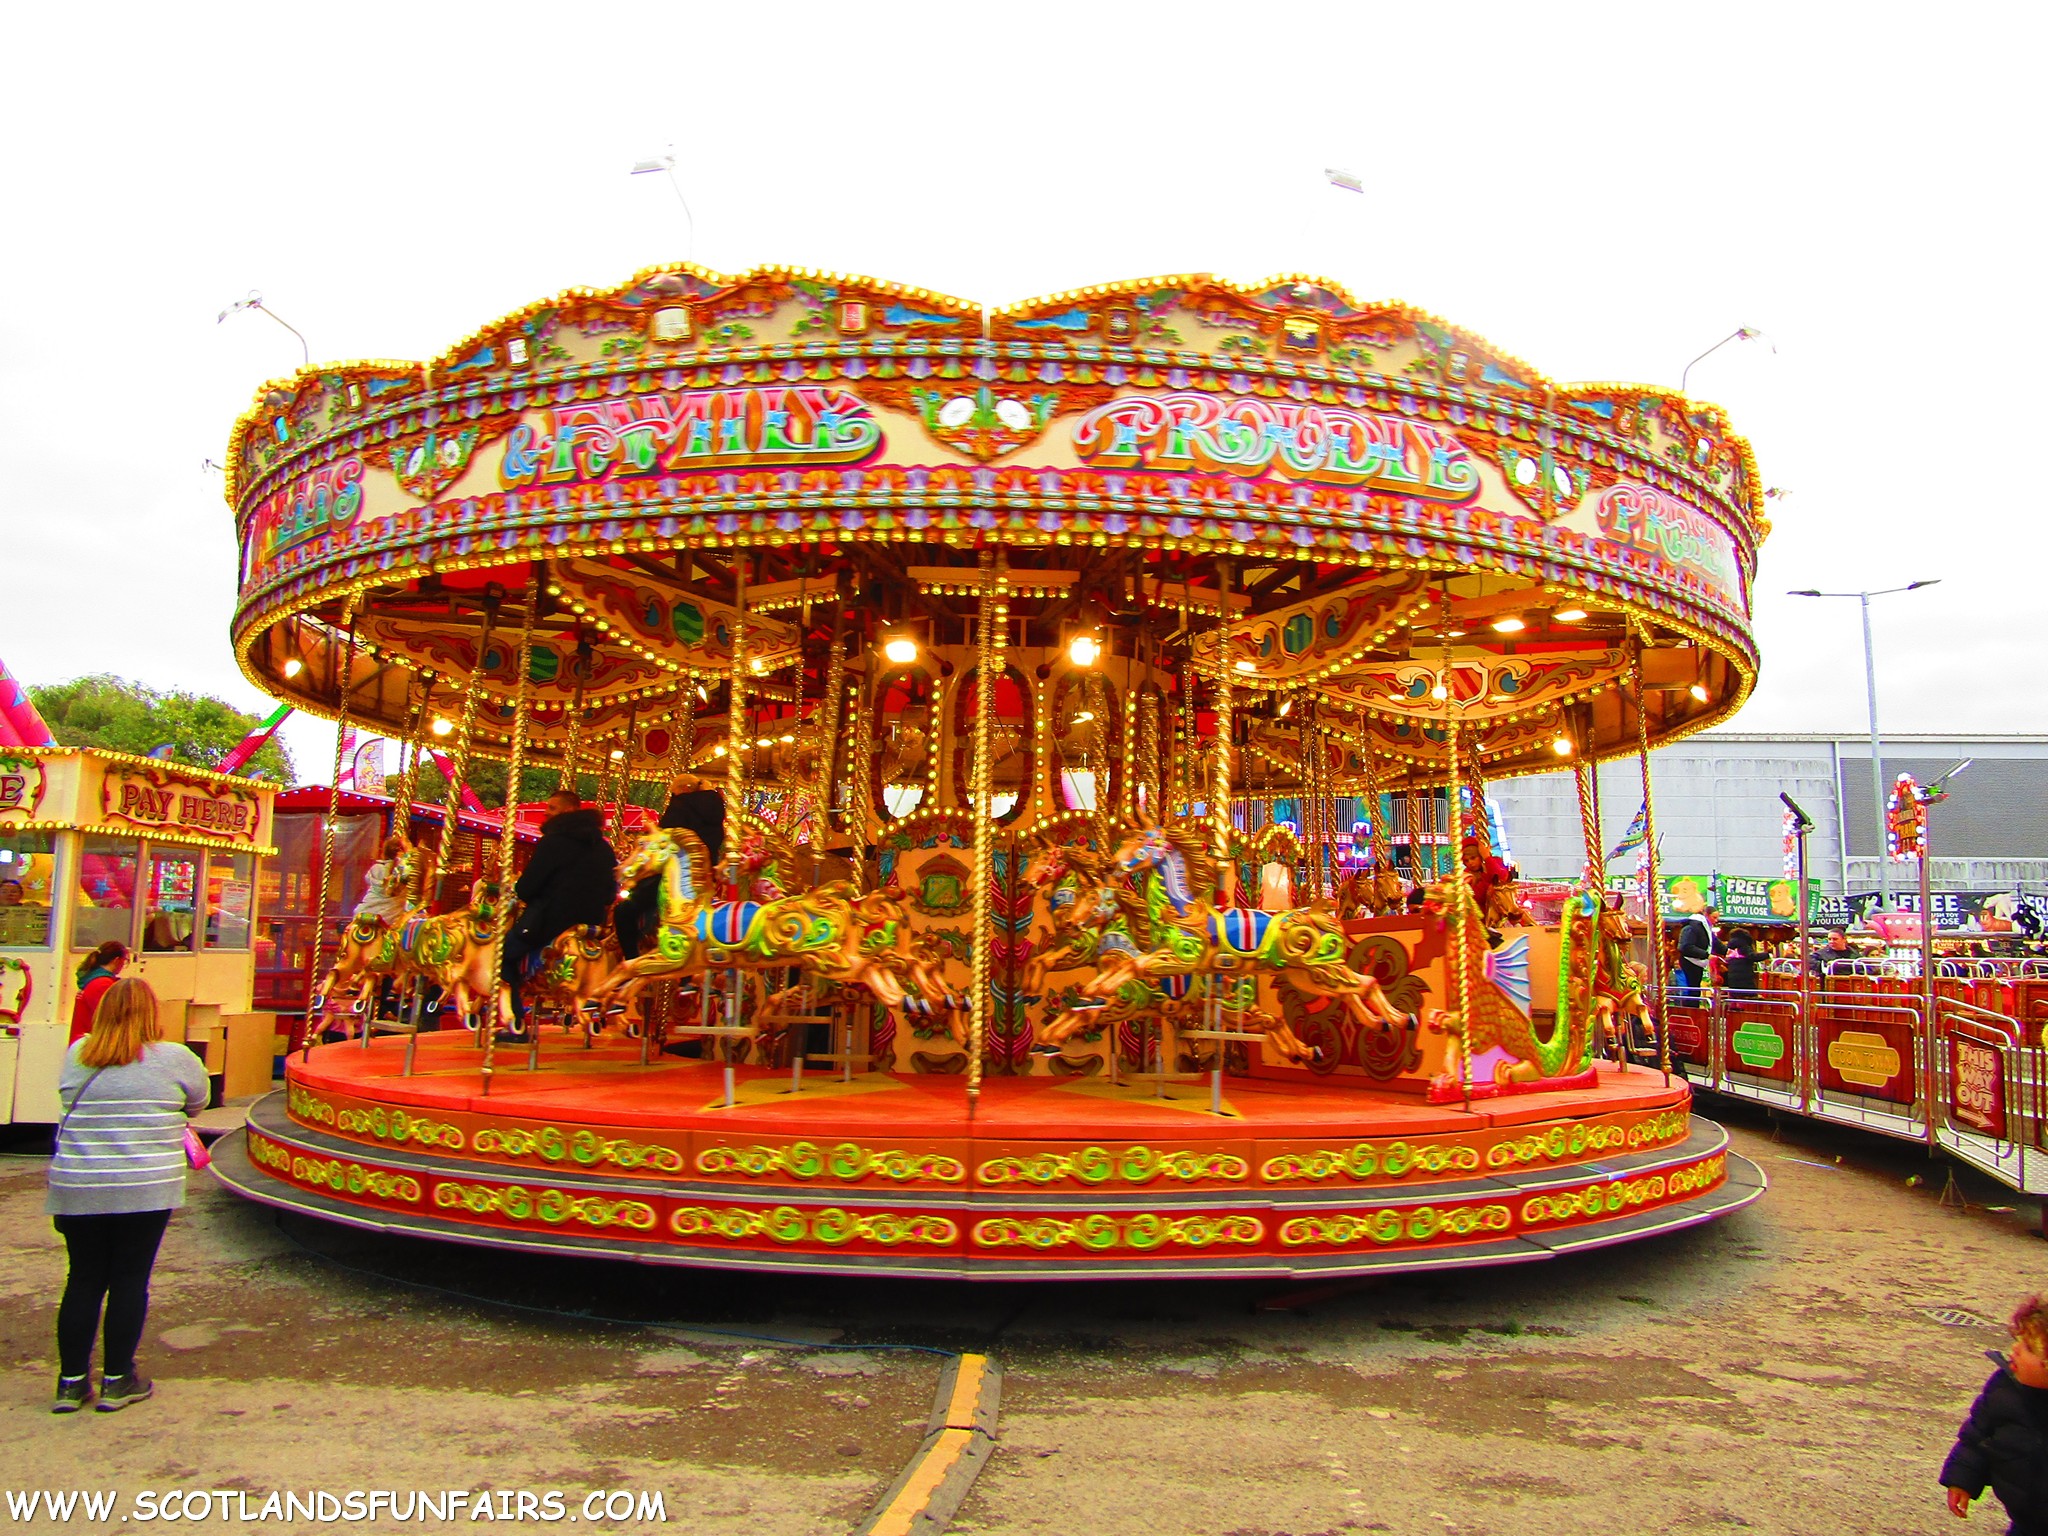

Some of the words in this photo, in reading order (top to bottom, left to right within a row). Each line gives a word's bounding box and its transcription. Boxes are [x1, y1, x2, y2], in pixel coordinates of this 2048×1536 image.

[1075, 391, 1483, 500] PROUDLY
[120, 784, 174, 821] PAY
[179, 794, 248, 830] HERE
[1726, 878, 1768, 896] FREE
[1733, 905, 1748, 915] YOU
[1749, 906, 1768, 916] LOSE
[1817, 896, 1849, 913] REE
[1833, 1047, 1861, 1067] TOON
[1863, 1050, 1895, 1073] TOWN
[1956, 1041, 1995, 1072] THIS
[1956, 1061, 1996, 1092] WAY
[1956, 1082, 1995, 1114] OUT
